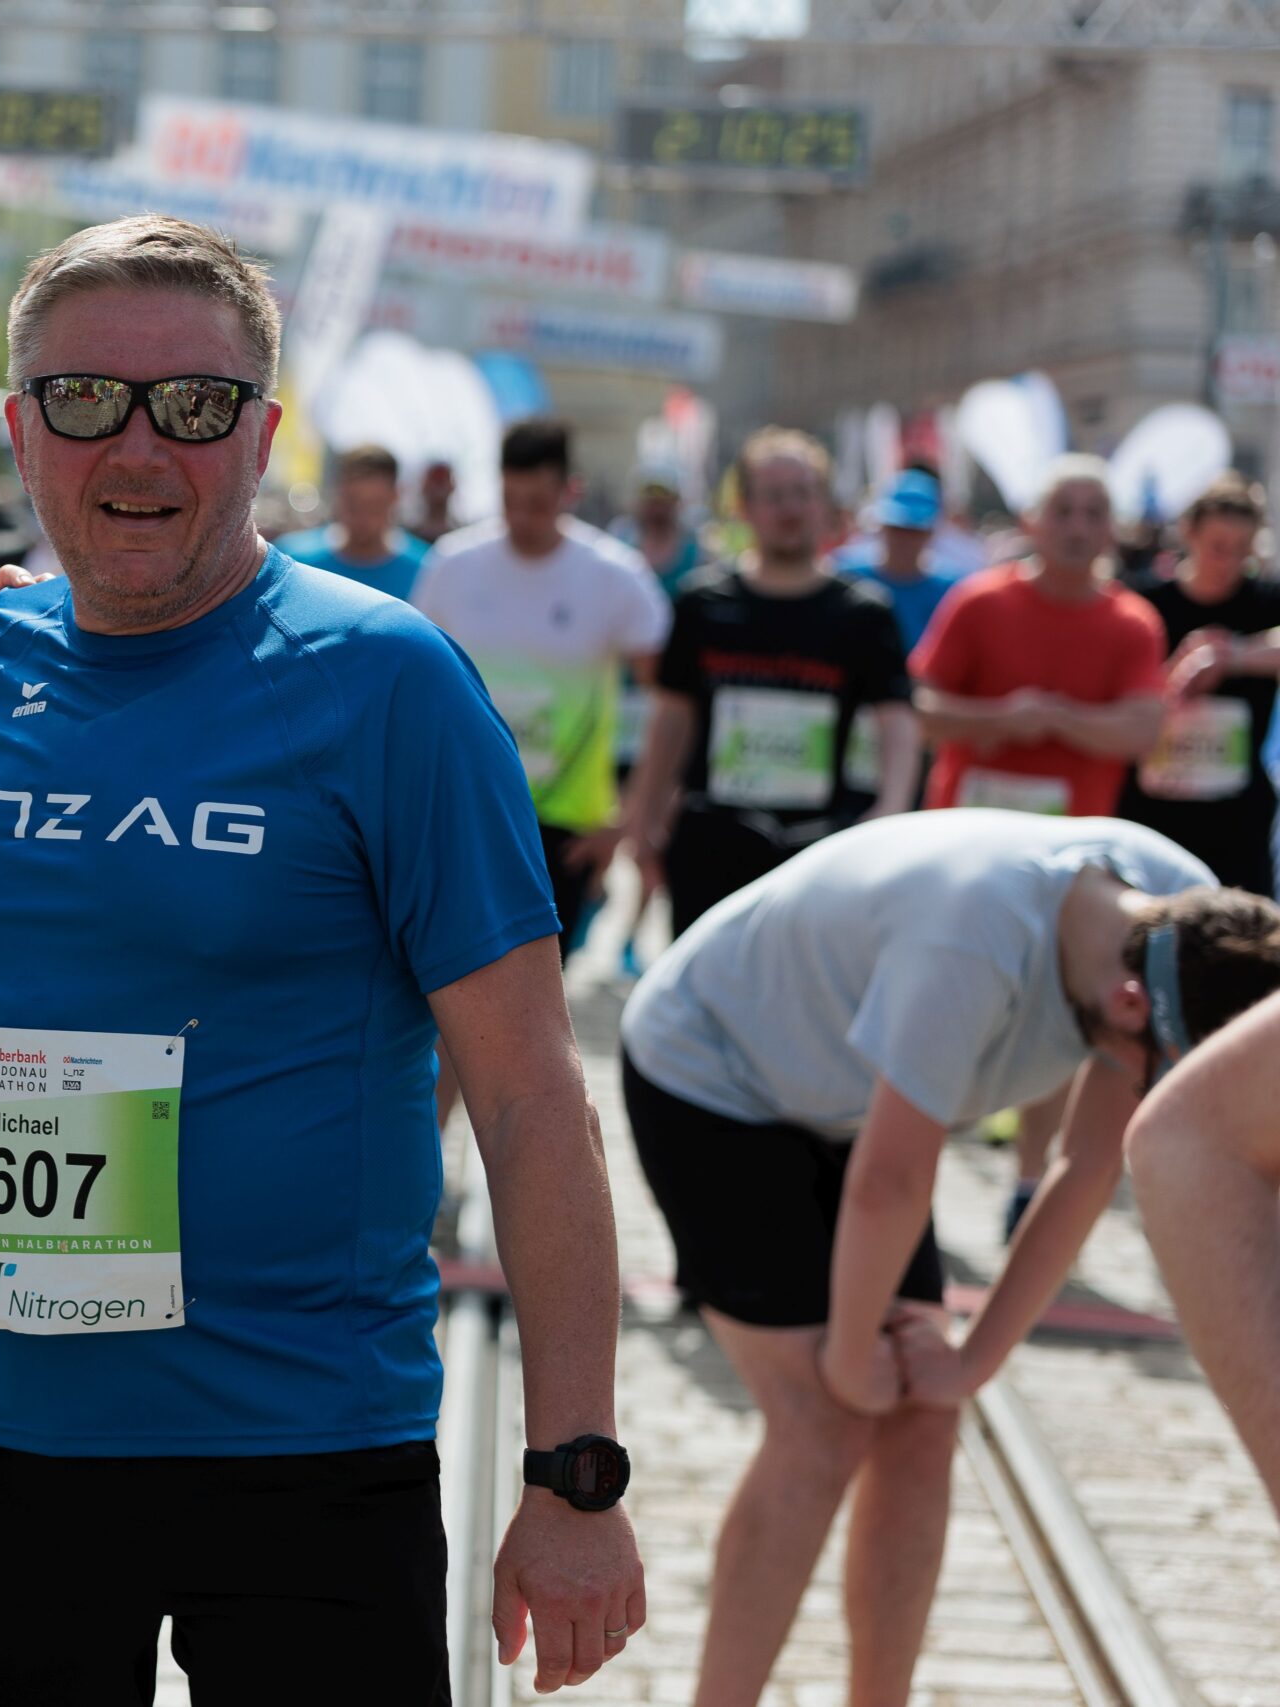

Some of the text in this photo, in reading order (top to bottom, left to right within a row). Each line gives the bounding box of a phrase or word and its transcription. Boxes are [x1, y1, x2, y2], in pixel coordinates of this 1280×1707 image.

[12, 699, 47, 718] erima
[105, 797, 265, 855] AG
[1, 1066, 47, 1078] DONAU
[8, 1289, 145, 1326] Nitrogen
